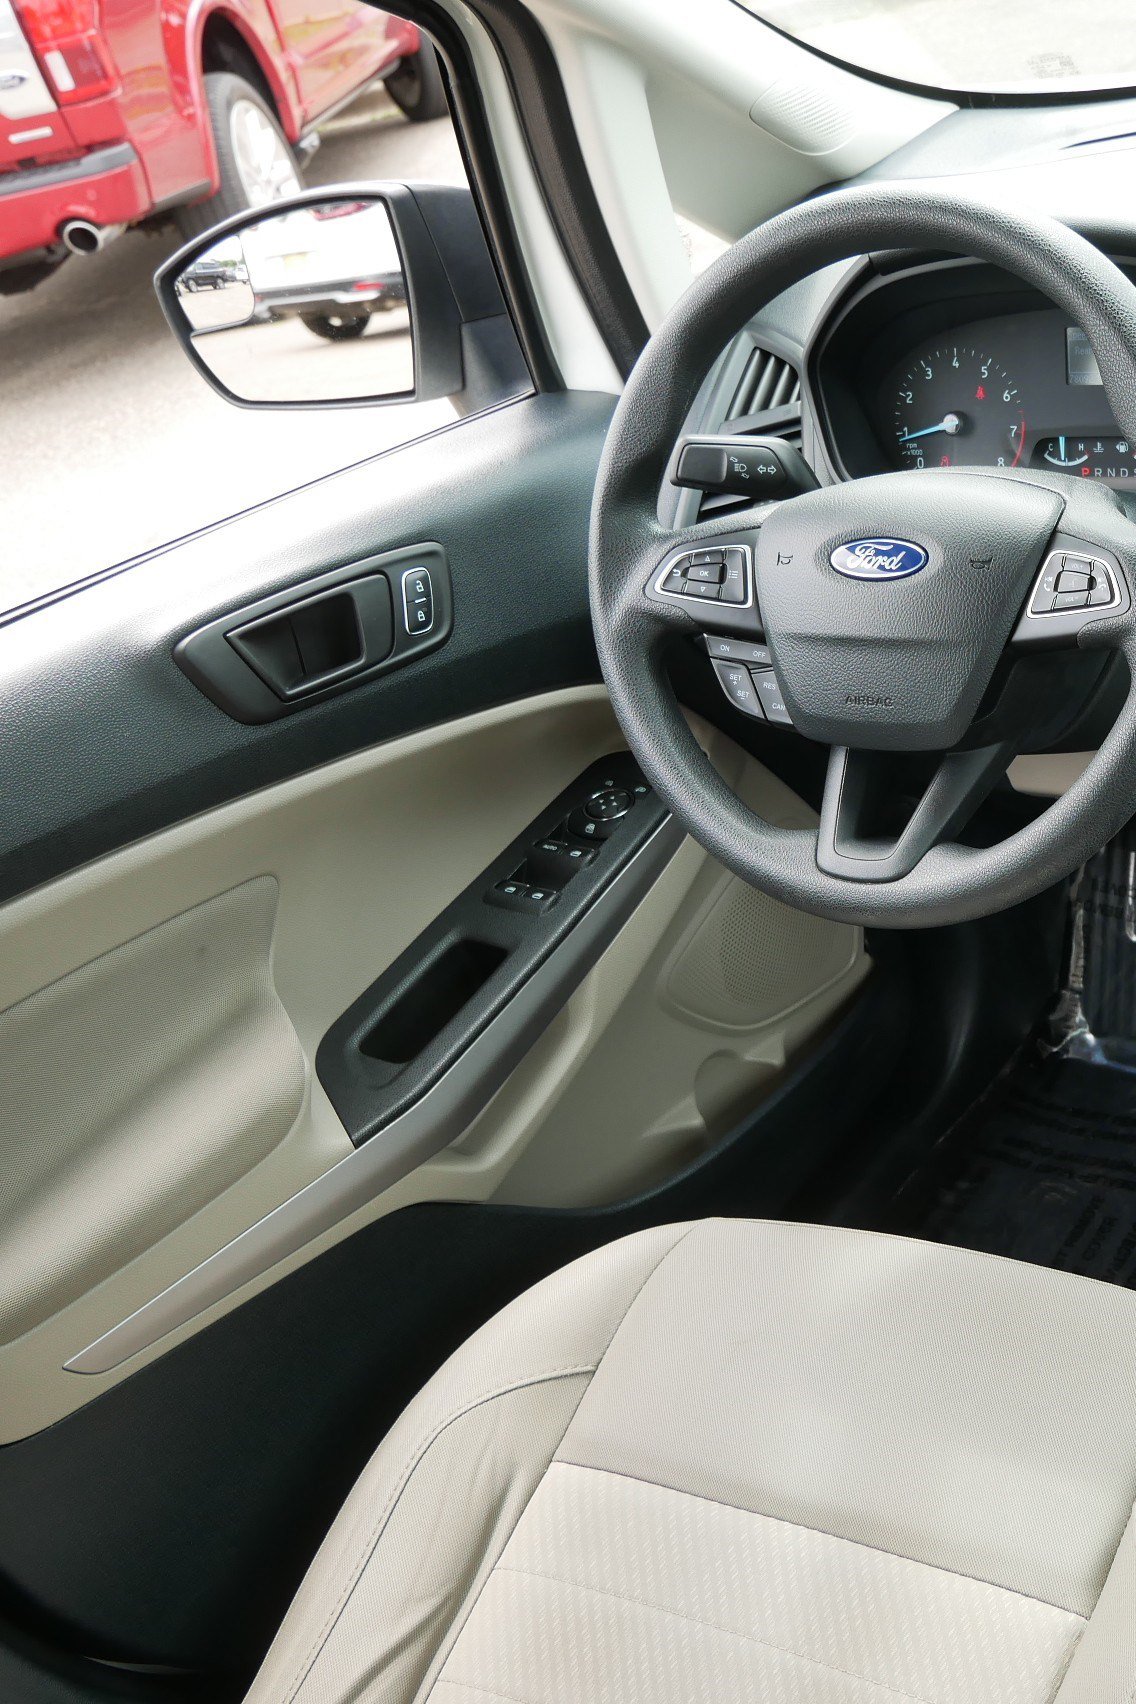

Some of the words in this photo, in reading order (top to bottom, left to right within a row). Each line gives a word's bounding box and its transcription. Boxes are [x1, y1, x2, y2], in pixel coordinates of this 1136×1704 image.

[952, 356, 960, 369] 4
[925, 367, 933, 380] 3
[981, 366, 988, 379] 5
[906, 392, 913, 404] 2
[1003, 390, 1011, 402] 6
[903, 427, 908, 439] 1
[1010, 425, 1018, 438] 7
[906, 442, 918, 450] rpm
[1048, 443, 1054, 451] C
[1078, 443, 1084, 451] H
[917, 457, 925, 469] 0
[1082, 467, 1090, 477] P
[1094, 468, 1103, 477] R
[1107, 468, 1116, 477] N
[1120, 468, 1129, 477] D
[846, 544, 903, 571] Ford
[752, 650, 766, 658] OFF
[729, 673, 742, 681] SET
[763, 682, 776, 690] RES
[736, 690, 750, 698] SET
